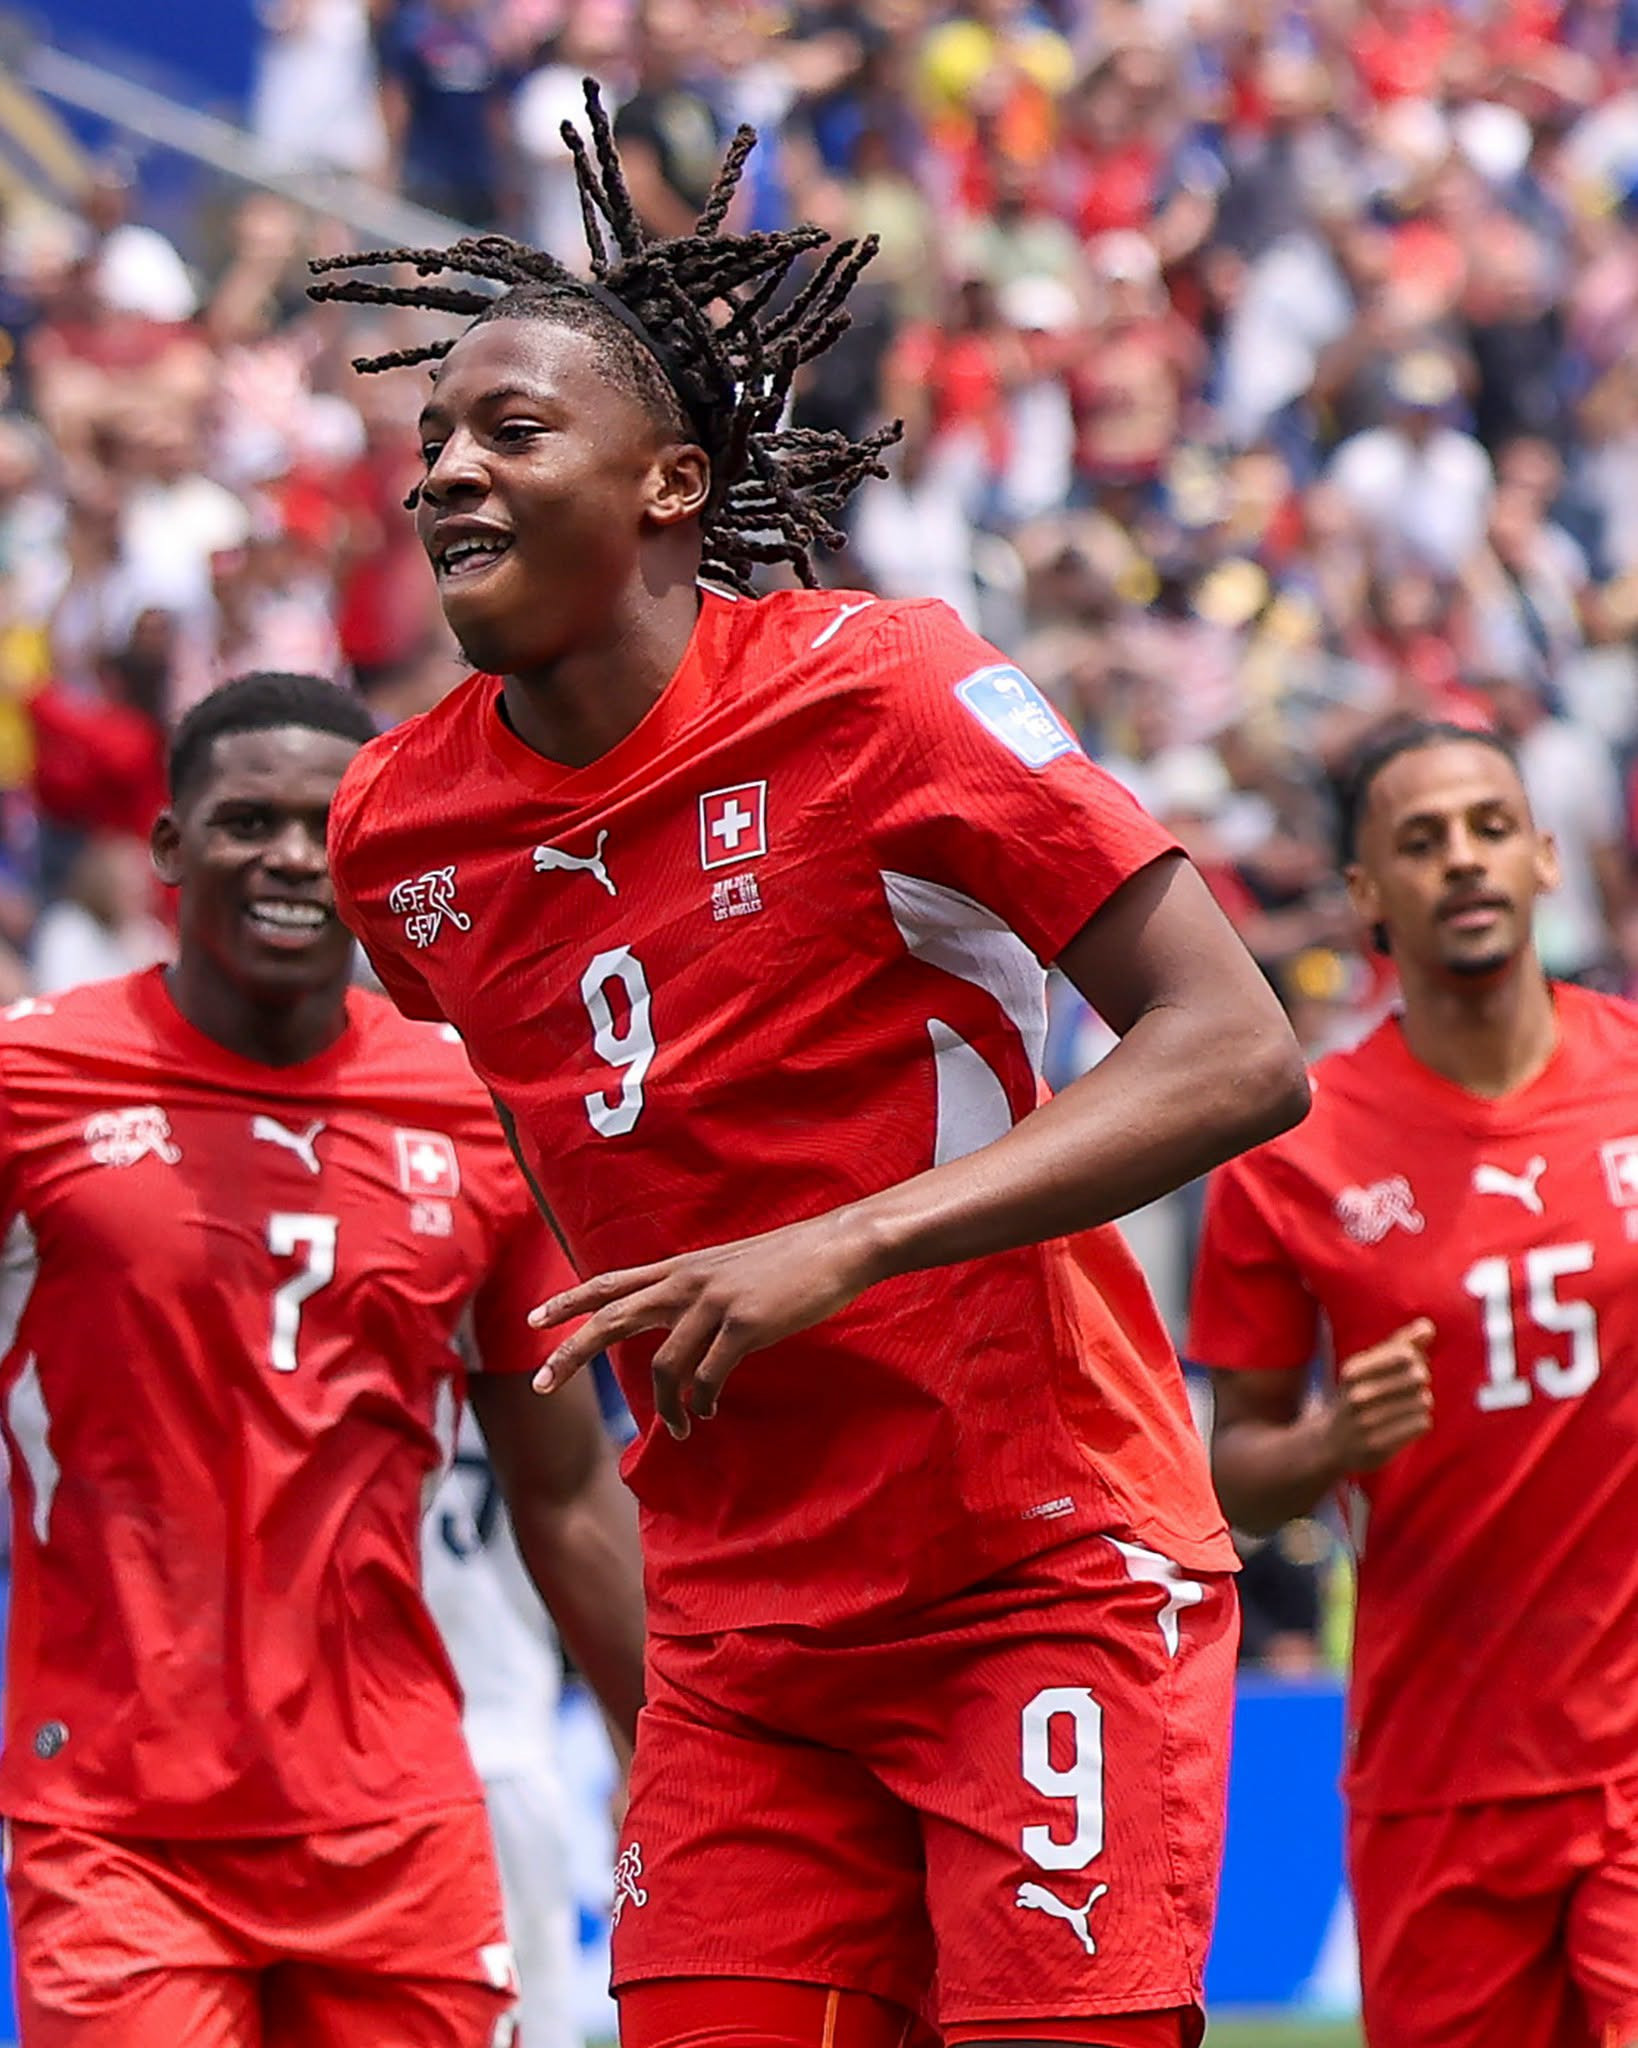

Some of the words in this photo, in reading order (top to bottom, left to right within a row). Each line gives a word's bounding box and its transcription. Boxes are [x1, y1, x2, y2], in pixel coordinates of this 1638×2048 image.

[580, 944, 656, 1138] 9
[267, 1212, 340, 1371] 7
[1464, 1241, 1600, 1409] 15
[1021, 1687, 1104, 1871] 9
